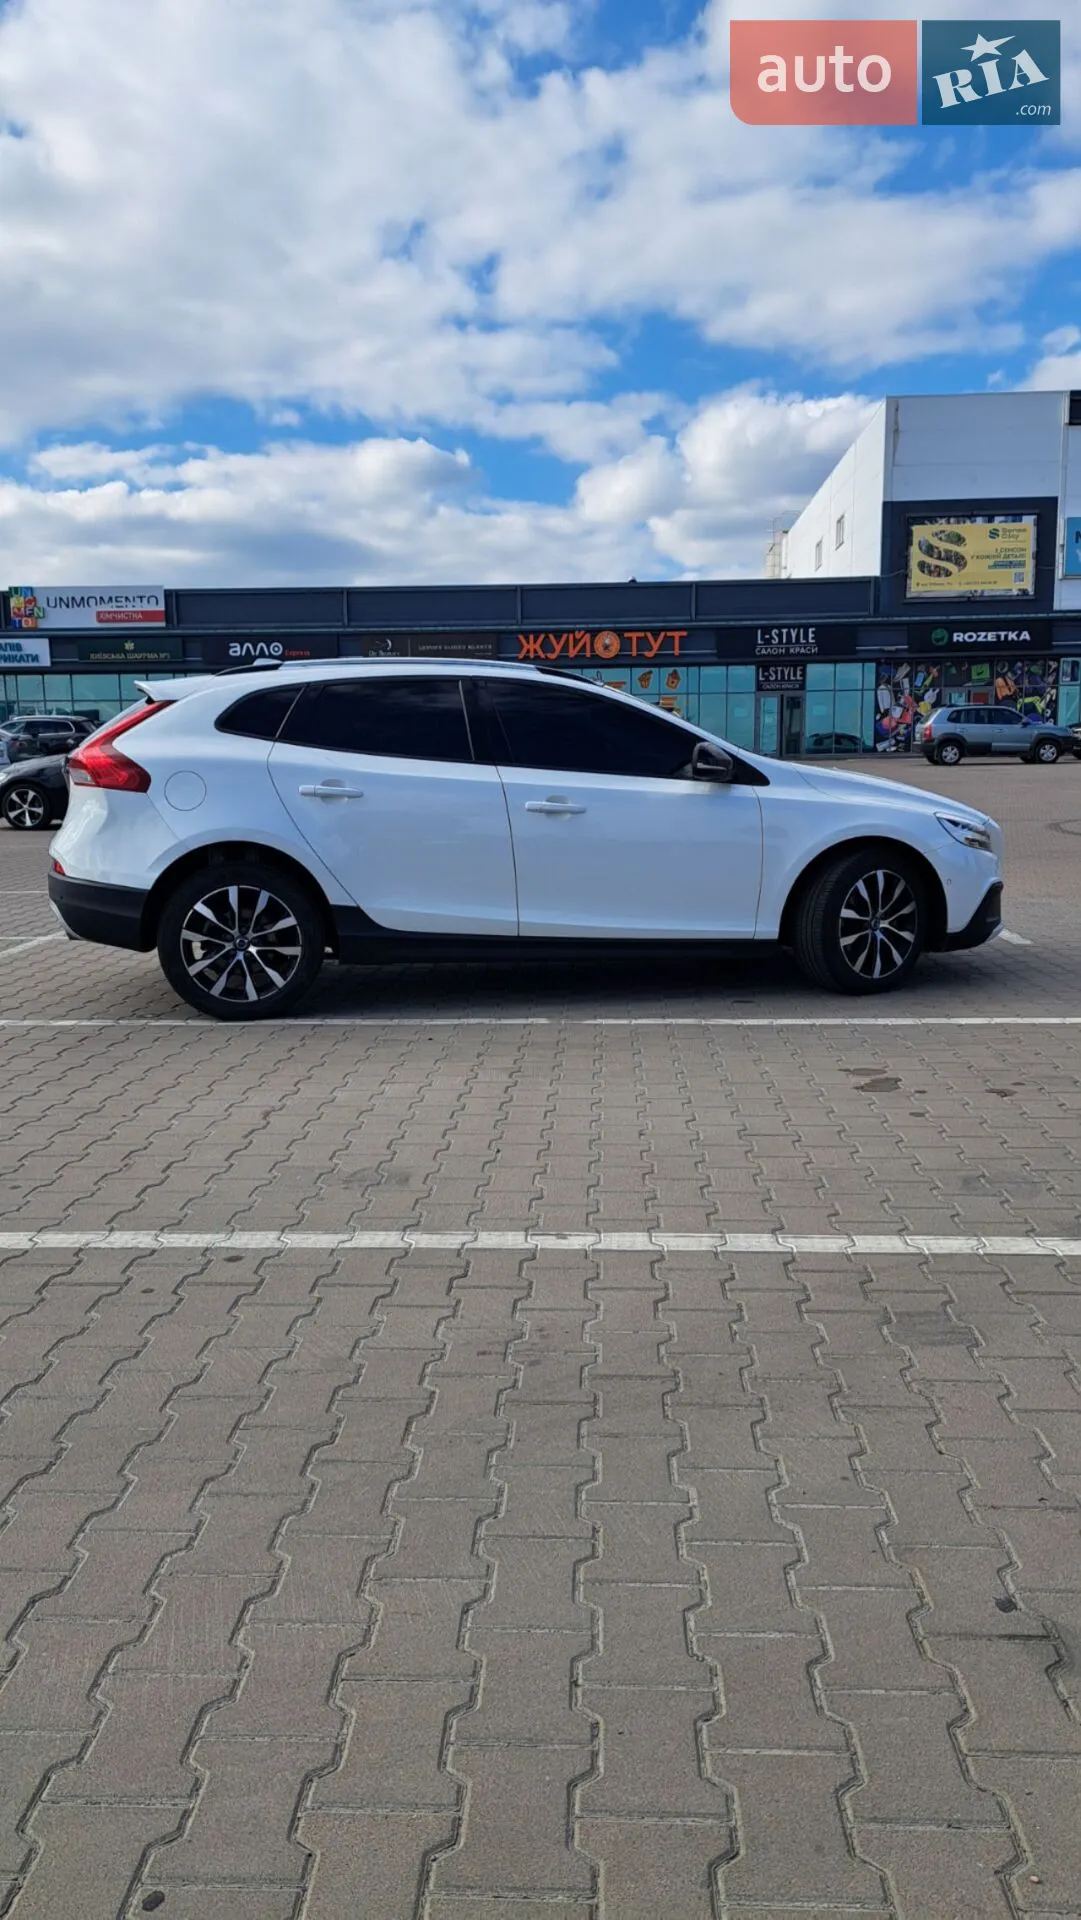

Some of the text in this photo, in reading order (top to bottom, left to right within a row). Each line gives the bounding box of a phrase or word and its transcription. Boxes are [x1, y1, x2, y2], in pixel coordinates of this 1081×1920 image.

[757, 627, 816, 644] L-STYLE
[952, 630, 1031, 642] ROZETKA
[518, 630, 688, 660] ЖУЙ ТУТ
[755, 646, 819, 655] САЛОН КРАСИ
[758, 666, 804, 681] L-STYLE
